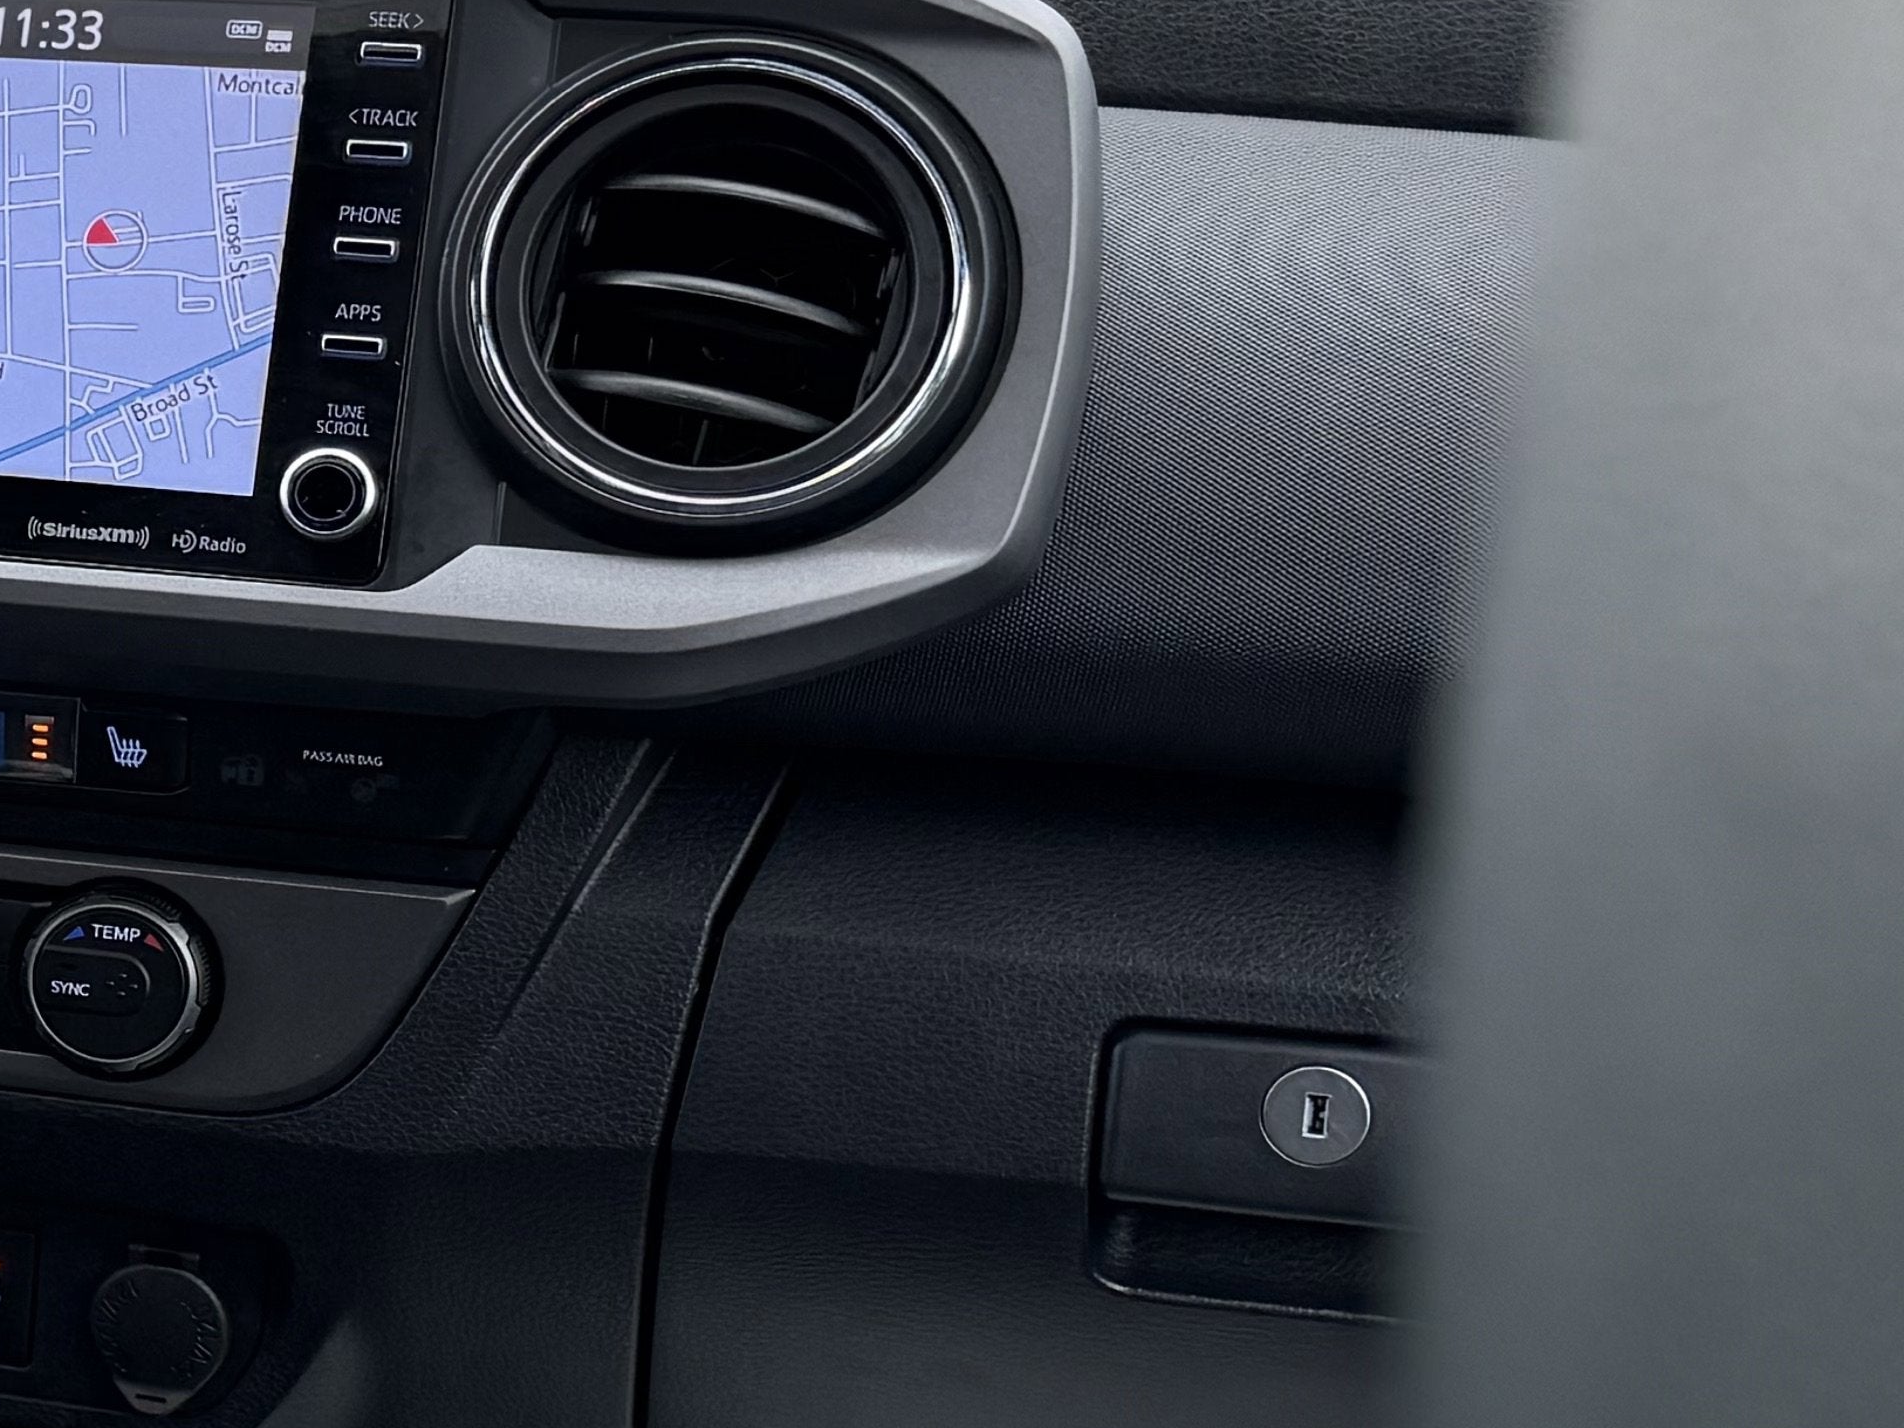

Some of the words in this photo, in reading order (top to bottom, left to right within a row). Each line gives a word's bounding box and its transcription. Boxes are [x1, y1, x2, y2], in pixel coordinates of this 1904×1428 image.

[222, 190, 241, 255] Larose
[339, 205, 403, 225] PHONE
[229, 259, 250, 281] St
[335, 303, 382, 322] APPS
[130, 387, 190, 423] Broad
[197, 373, 218, 396] St
[327, 403, 366, 420] TUNE
[316, 420, 370, 437] SCROLL
[199, 535, 247, 556] Radio
[92, 923, 141, 943] TEMP
[50, 980, 91, 997] SYNC
